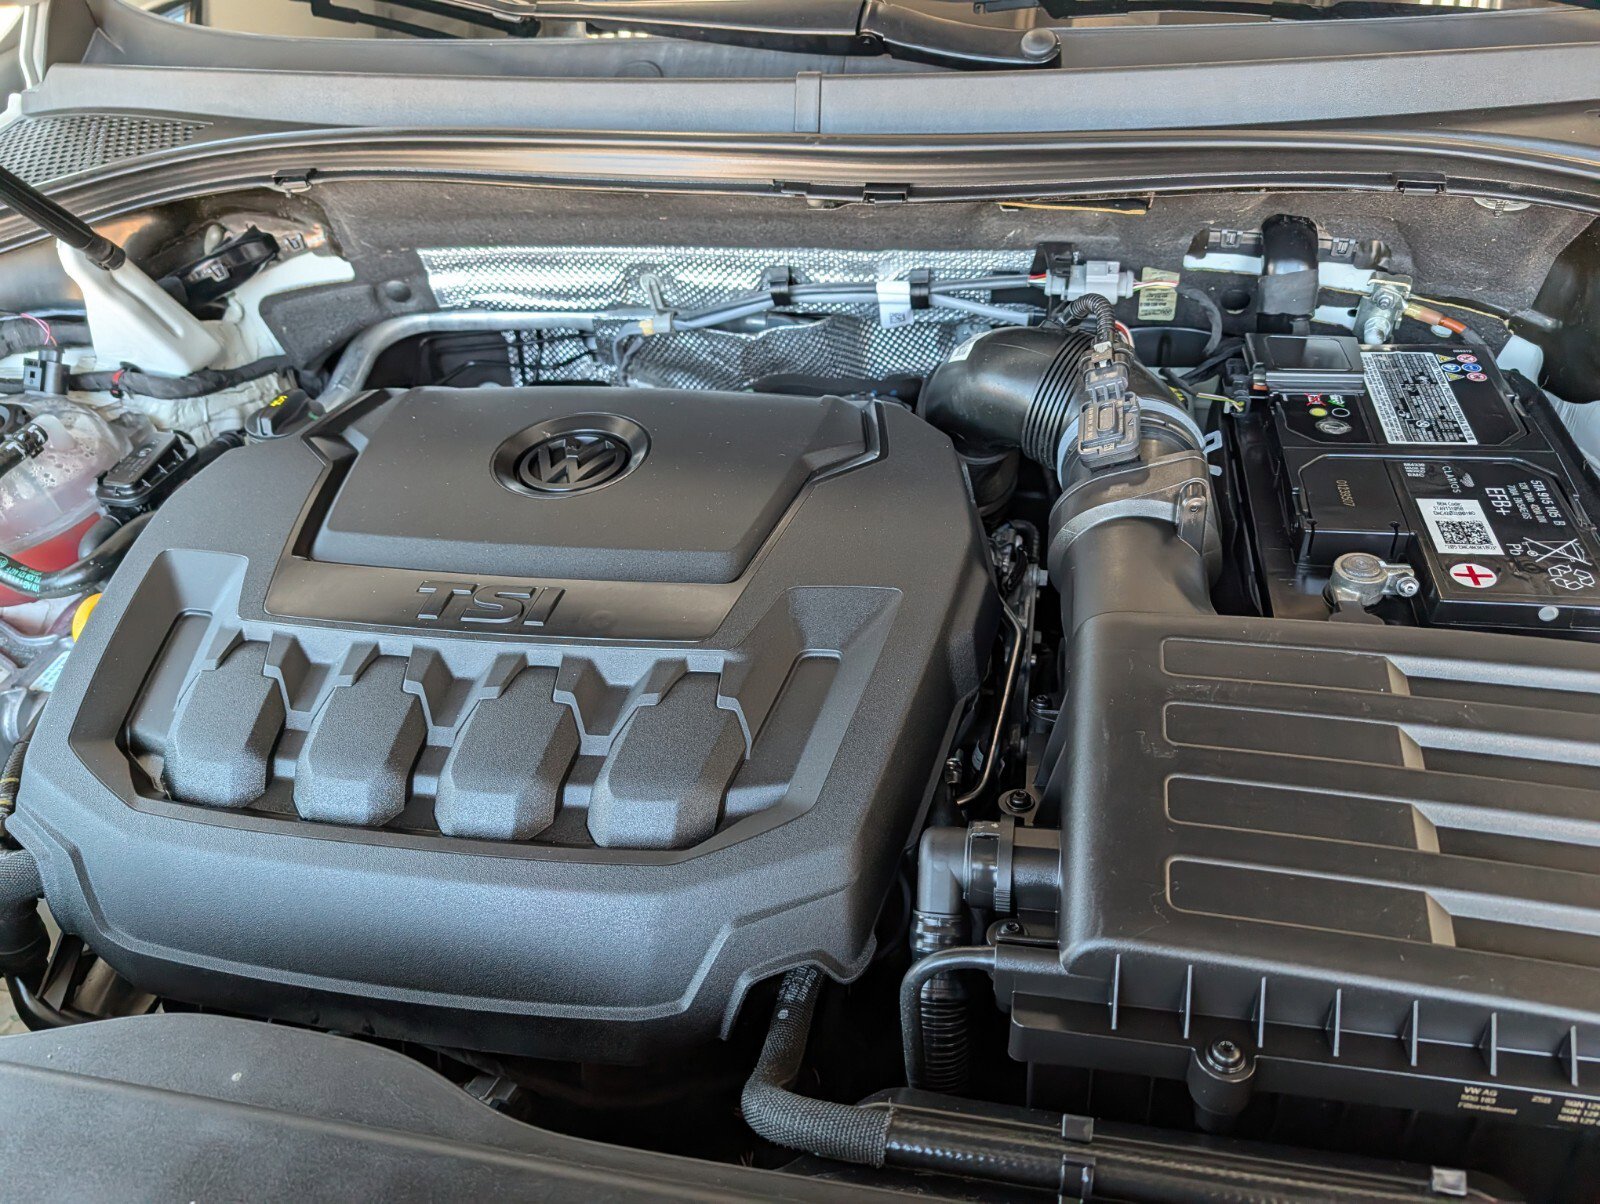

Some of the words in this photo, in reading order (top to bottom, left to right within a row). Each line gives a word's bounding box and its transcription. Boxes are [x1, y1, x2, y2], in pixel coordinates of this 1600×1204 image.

[1442, 466, 1461, 493] CLARIOS
[1530, 479, 1547, 492] 5TA
[1484, 487, 1513, 516] EFB+
[1537, 492, 1554, 505] 915
[1545, 506, 1562, 518] 105
[1505, 543, 1524, 556] Pb
[417, 579, 567, 627] TSI
[1464, 1086, 1481, 1095] VW
[1482, 1089, 1498, 1097] AG
